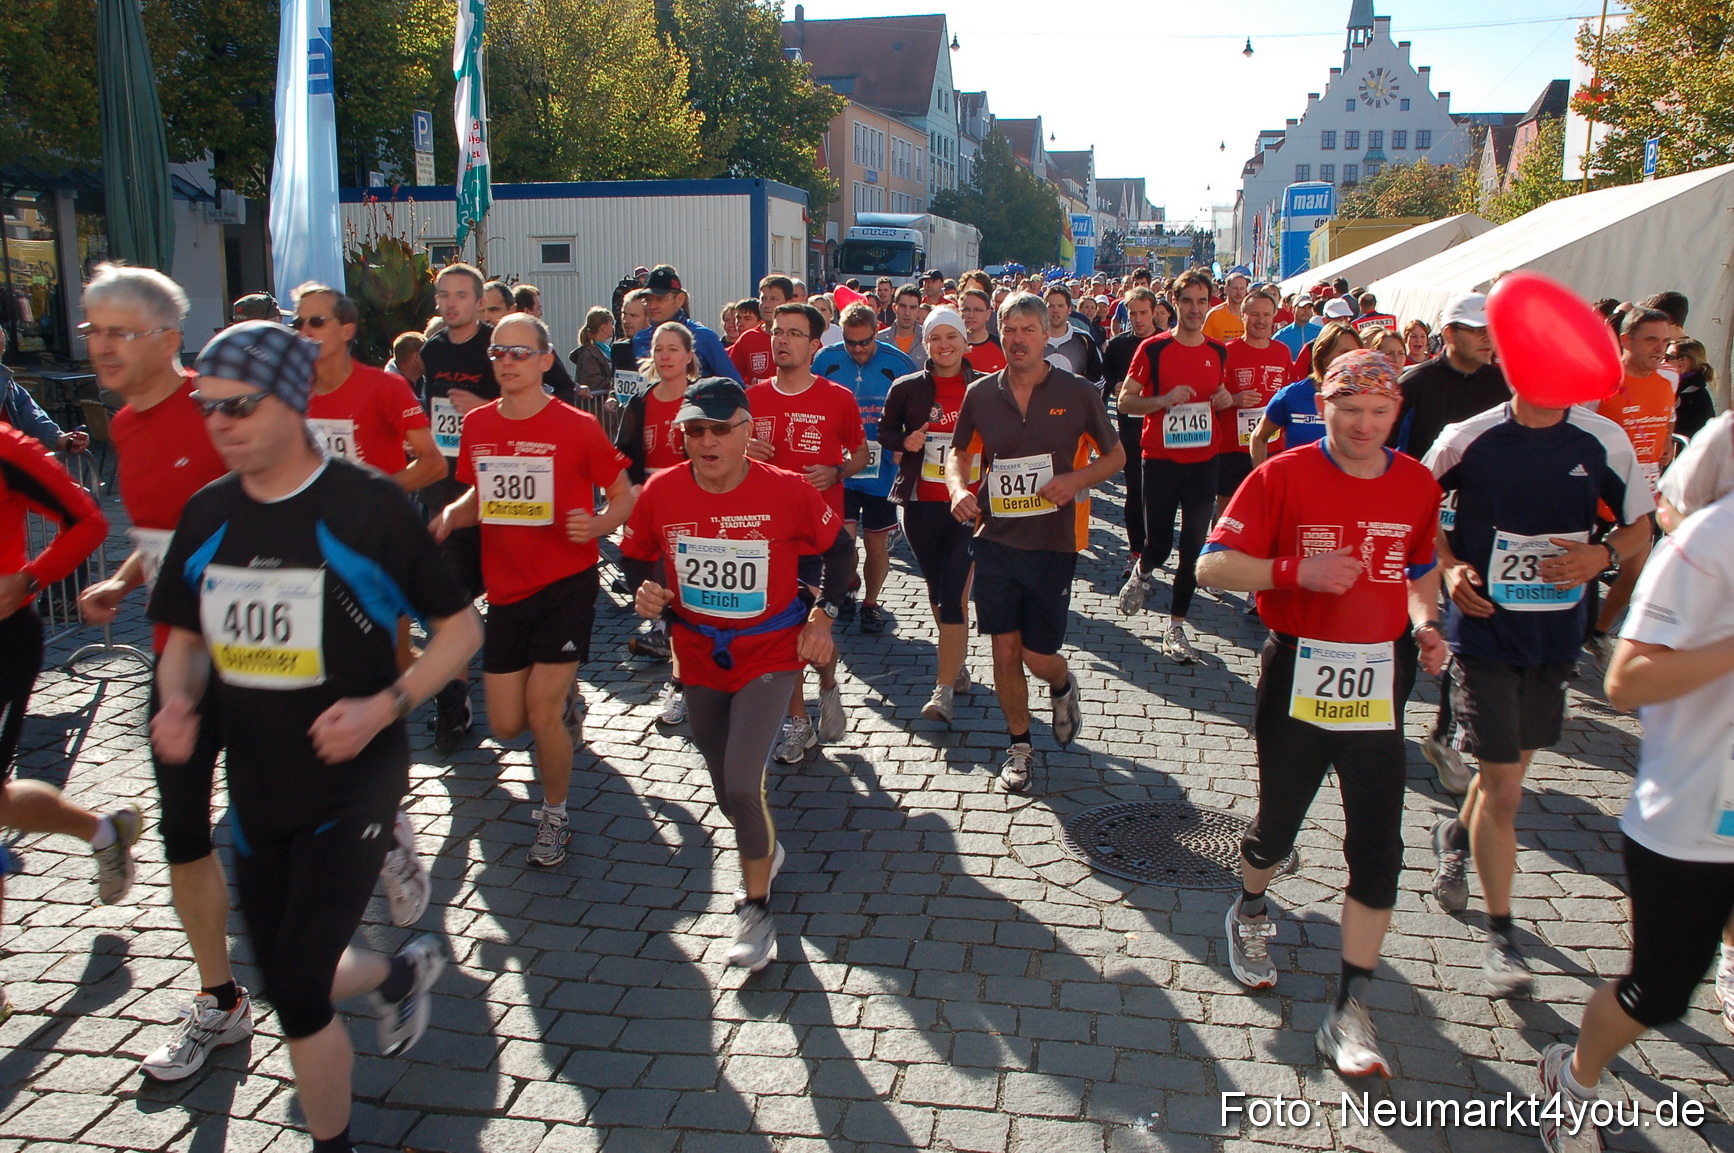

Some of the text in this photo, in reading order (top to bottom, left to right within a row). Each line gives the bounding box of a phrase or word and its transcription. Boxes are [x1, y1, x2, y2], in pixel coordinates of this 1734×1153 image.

[1293, 190, 1330, 210] maxi
[1073, 220, 1089, 232] axi
[1359, 319, 1393, 330] NOTARZT
[617, 380, 639, 395] 302
[940, 410, 961, 426] BIR
[1168, 414, 1208, 432] 2146
[1172, 431, 1206, 442] Michael
[493, 474, 535, 500] 380
[1000, 472, 1038, 496] 847
[487, 501, 544, 516] Christian
[1003, 496, 1042, 510] Gerald
[721, 514, 772, 522] NEUMARKTER
[688, 544, 726, 554] PFLEIDERER
[685, 558, 757, 591] 2380
[1501, 554, 1559, 582] 23
[701, 590, 740, 608] Erich
[223, 600, 294, 644] 406
[1312, 648, 1357, 660] PFLEIDERER
[1315, 665, 1374, 698] 260
[1315, 700, 1370, 718] Harald
